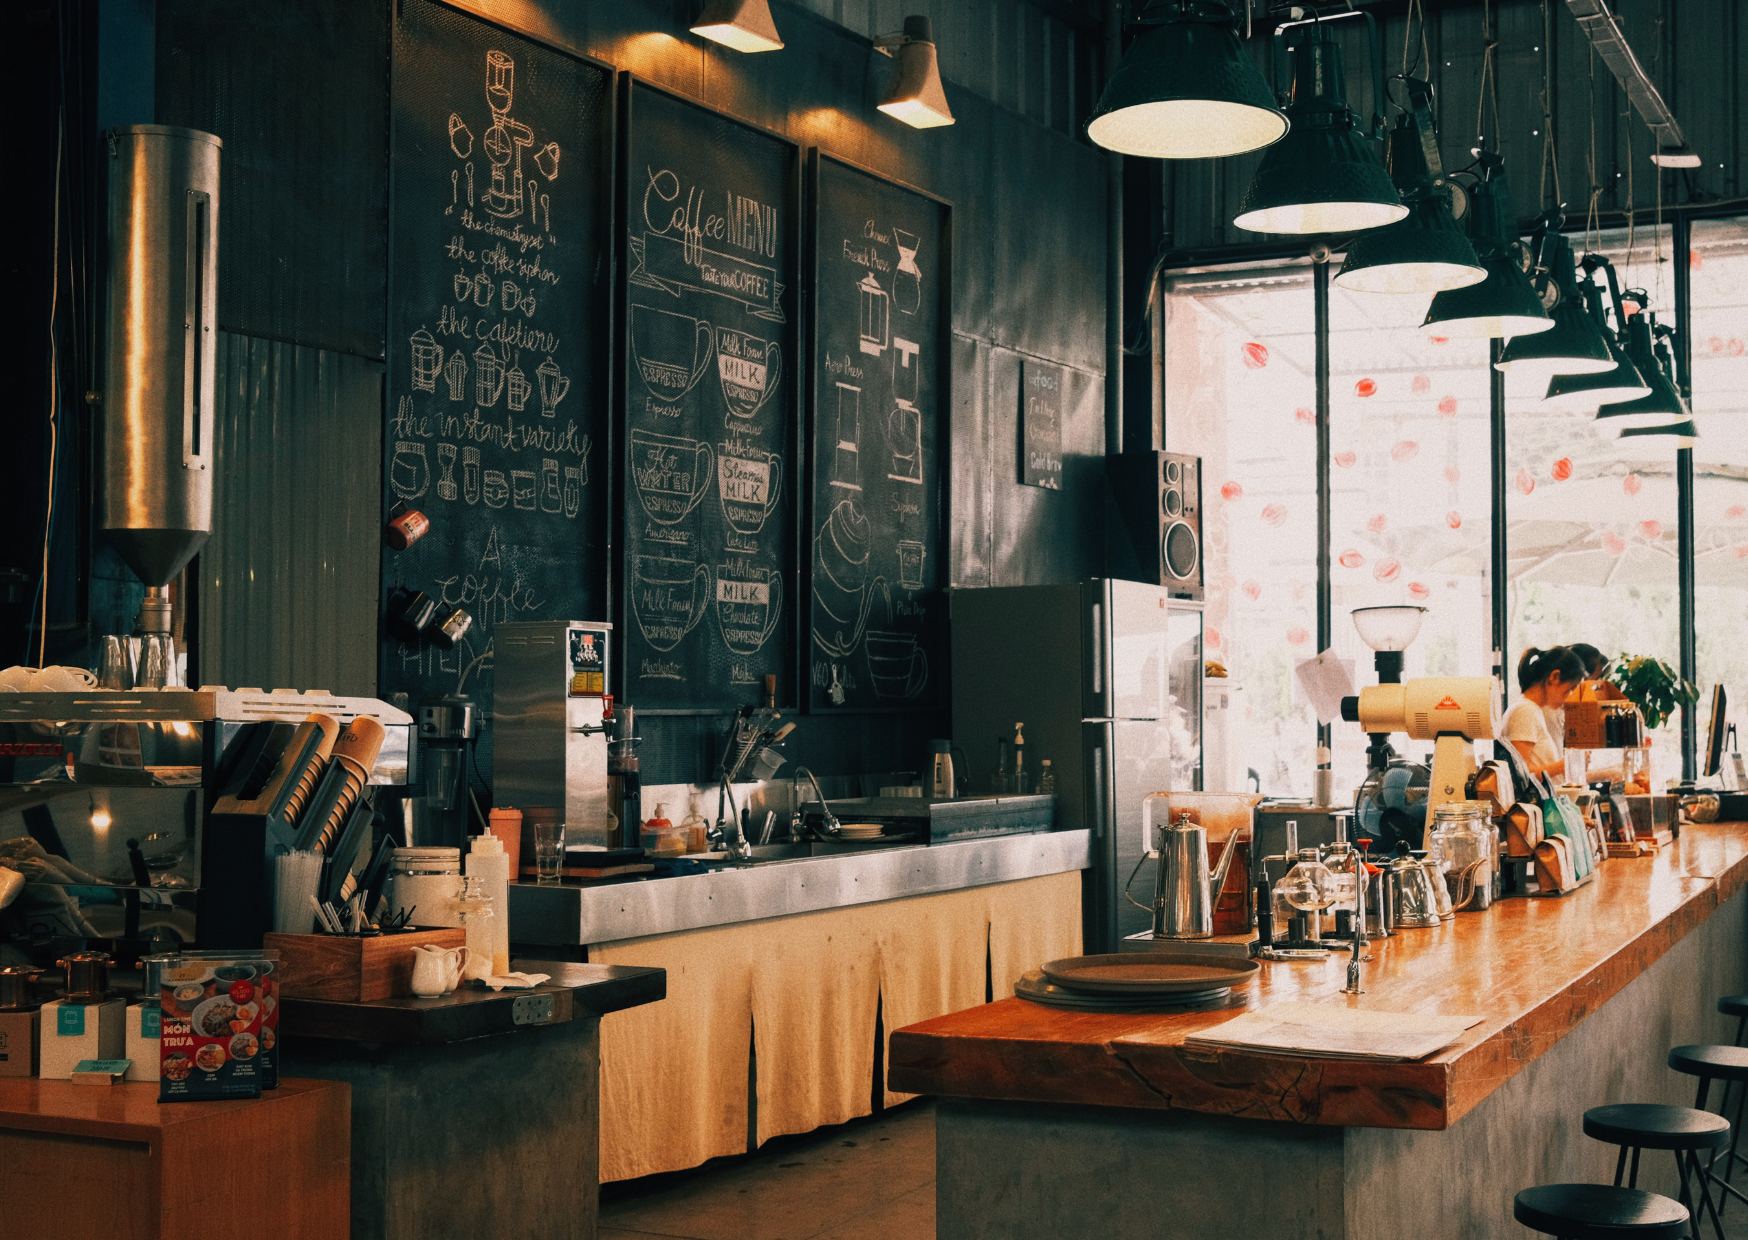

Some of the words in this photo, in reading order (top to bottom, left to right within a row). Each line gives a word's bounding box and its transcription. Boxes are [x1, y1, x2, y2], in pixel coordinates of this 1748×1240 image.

[643, 164, 726, 268] Coffee
[727, 190, 777, 258] MENU
[444, 235, 477, 263] the
[735, 269, 770, 299] COFFEE
[436, 304, 472, 339] the
[724, 358, 761, 385] MILK
[389, 394, 434, 439] the
[434, 406, 521, 452] instant
[518, 418, 593, 486] variety
[726, 480, 761, 502] MILK
[478, 523, 501, 571] A
[722, 583, 760, 602] MILK
[163, 1023, 191, 1035] MÓN
[163, 1036, 194, 1047] TRƯA
